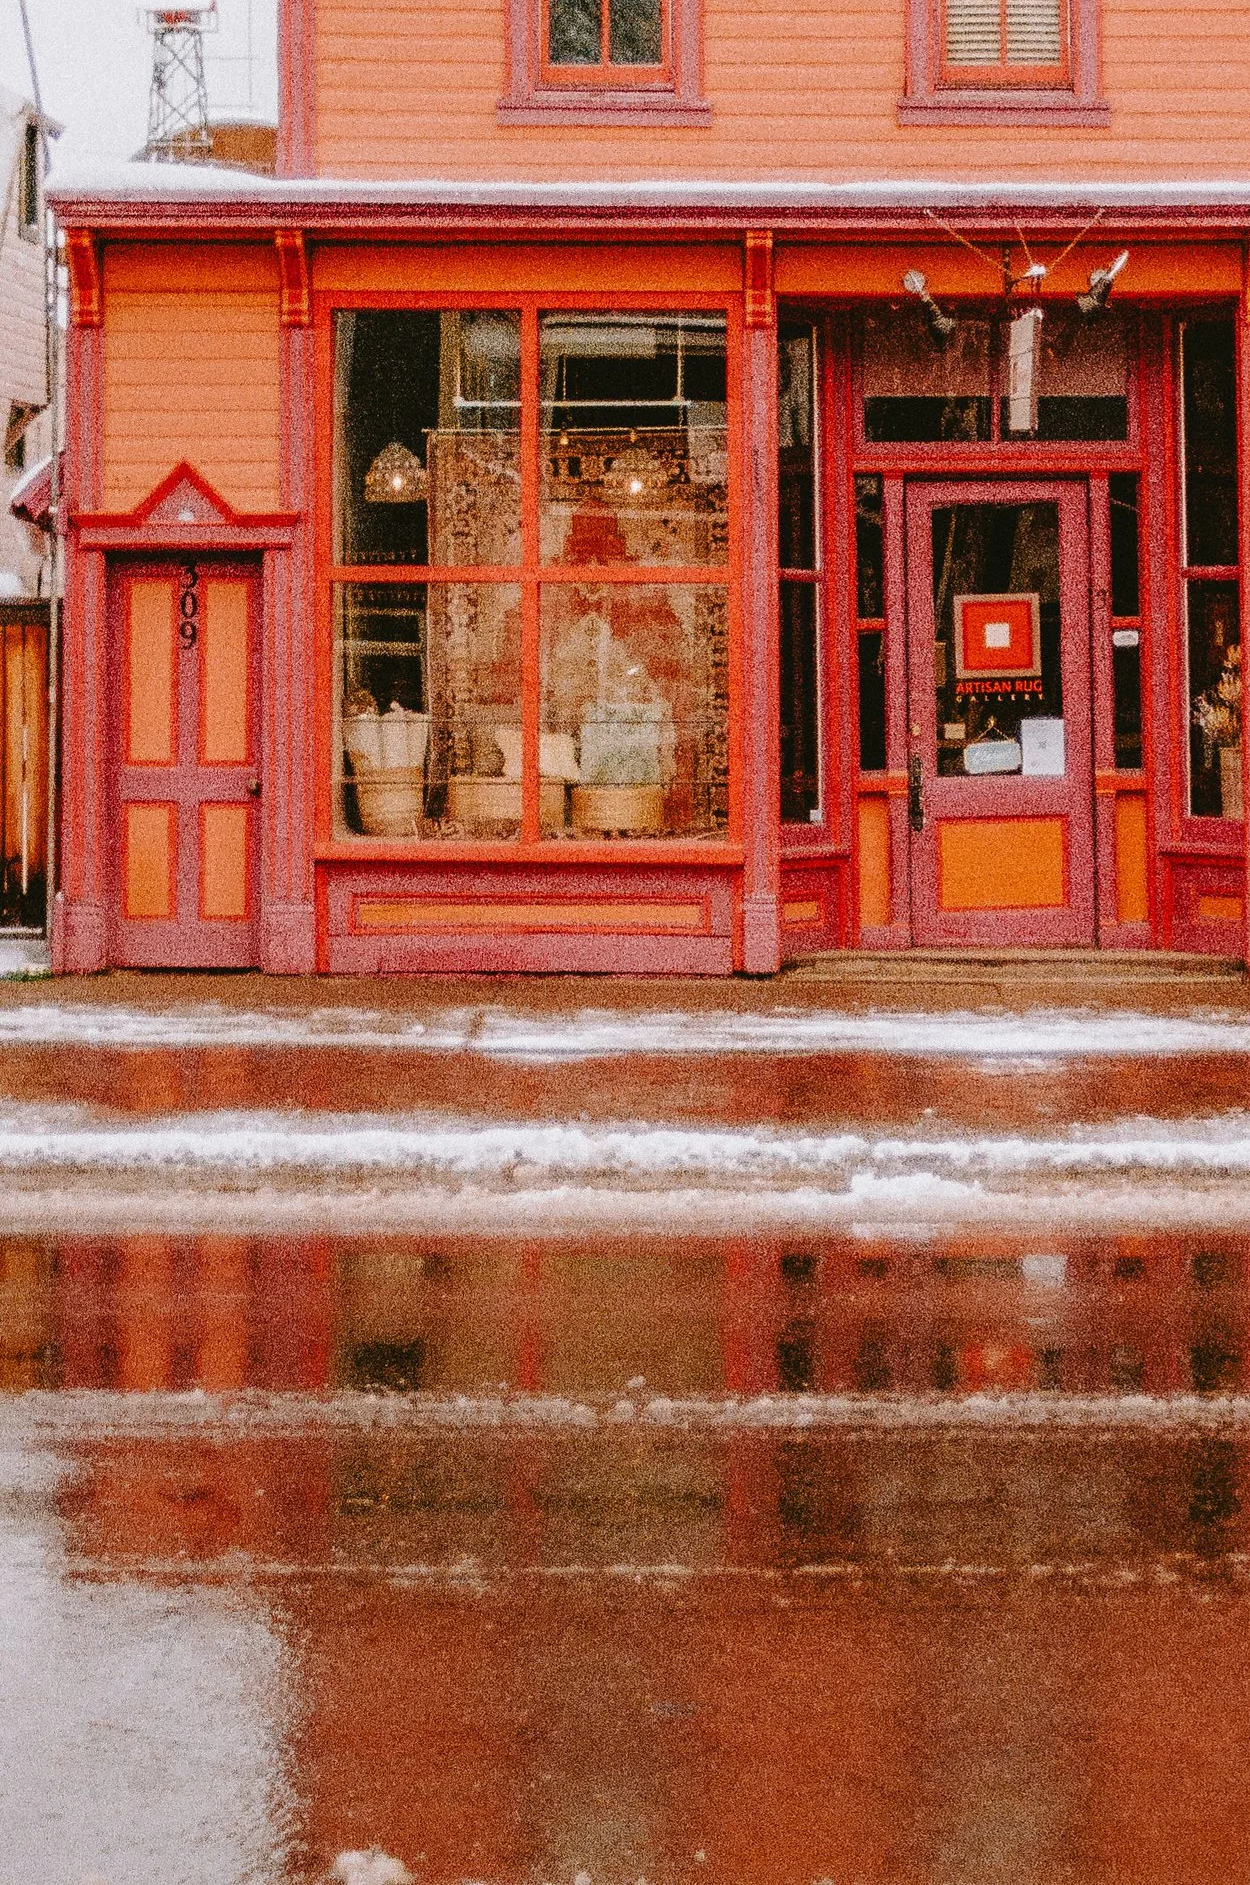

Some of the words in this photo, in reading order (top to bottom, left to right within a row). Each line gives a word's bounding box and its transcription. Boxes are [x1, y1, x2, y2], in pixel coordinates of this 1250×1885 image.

[180, 563, 199, 650] 309
[956, 682, 1011, 693] ARTISAN
[1015, 680, 1042, 691] RUG
[955, 693, 1044, 703] GALLERY
